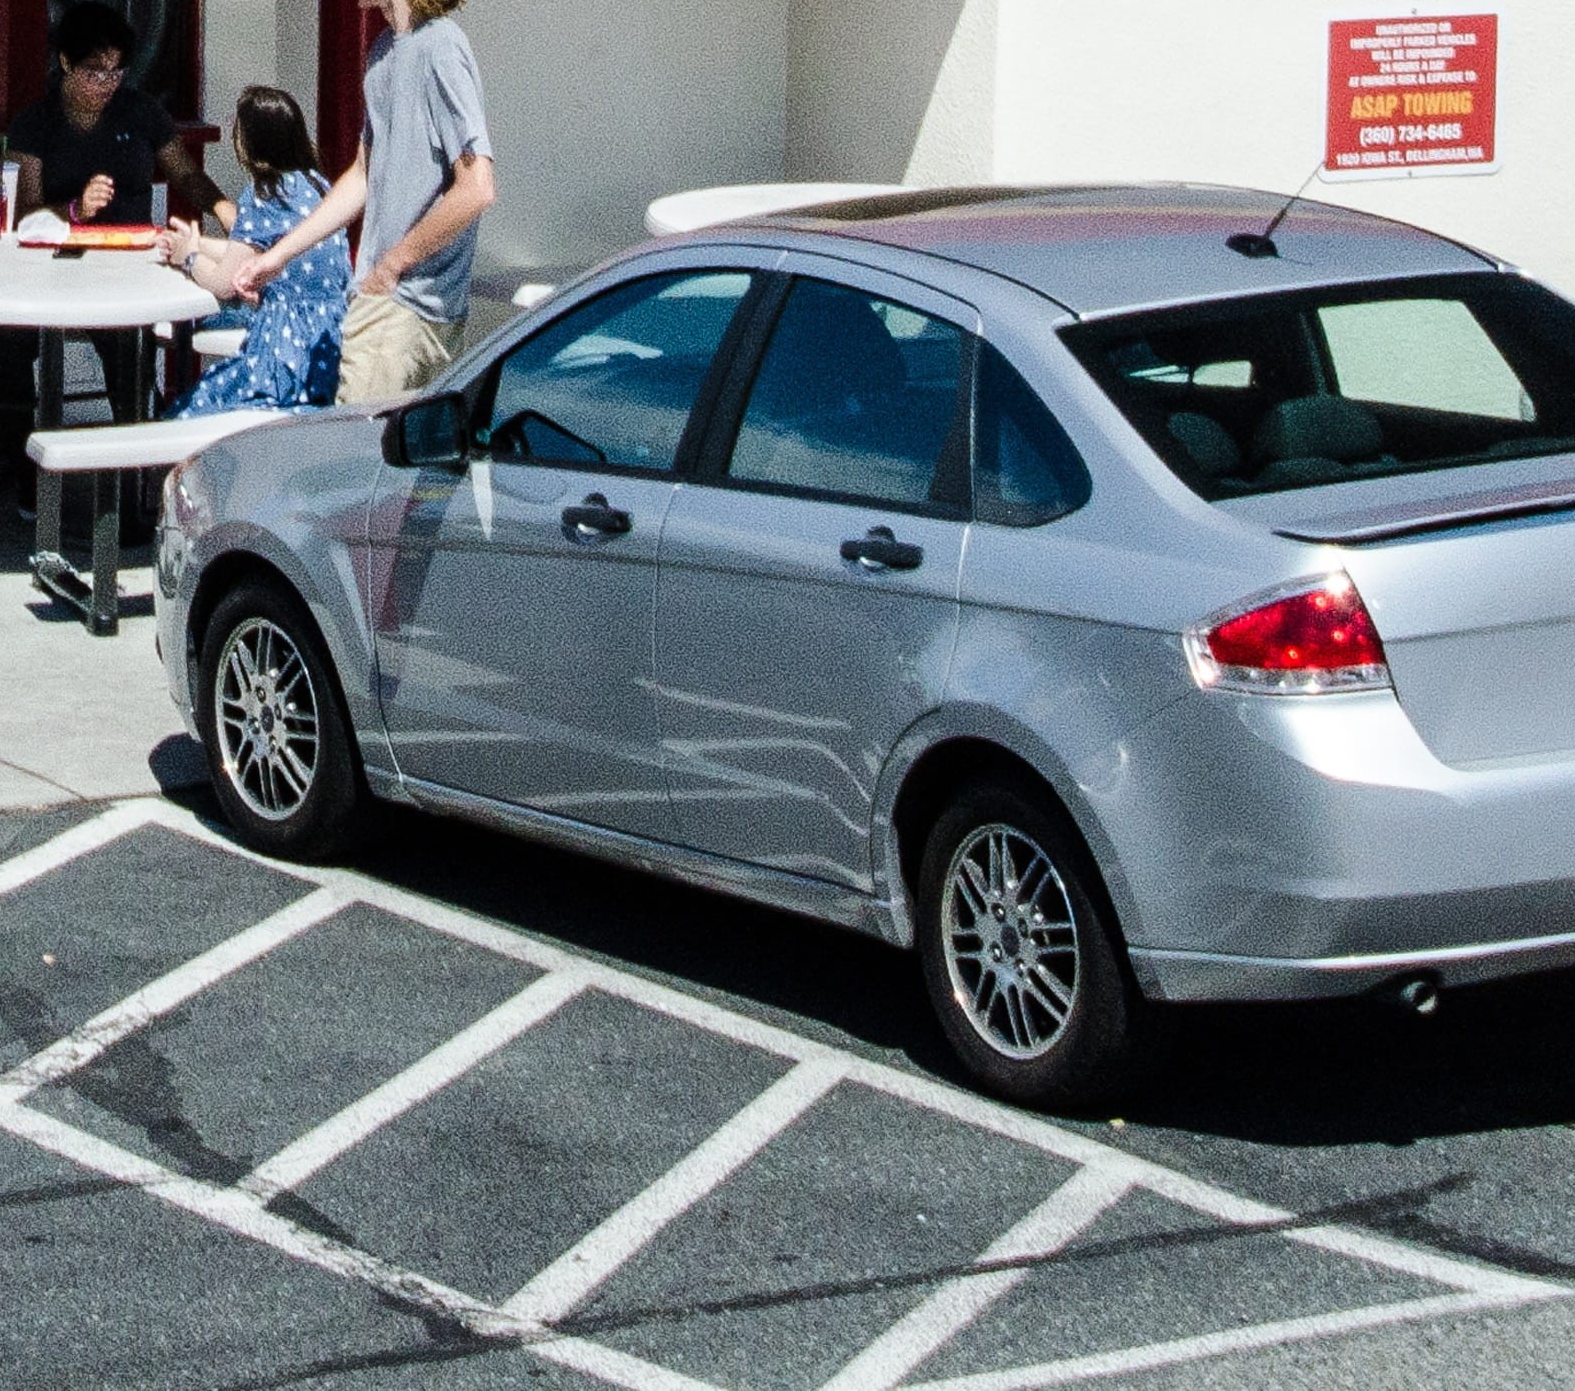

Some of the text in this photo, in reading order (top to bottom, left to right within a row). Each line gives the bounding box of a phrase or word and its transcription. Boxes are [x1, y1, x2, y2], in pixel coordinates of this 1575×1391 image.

[1350, 91, 1474, 119] ASAP TOWING
[1360, 125, 1395, 147] (360)
